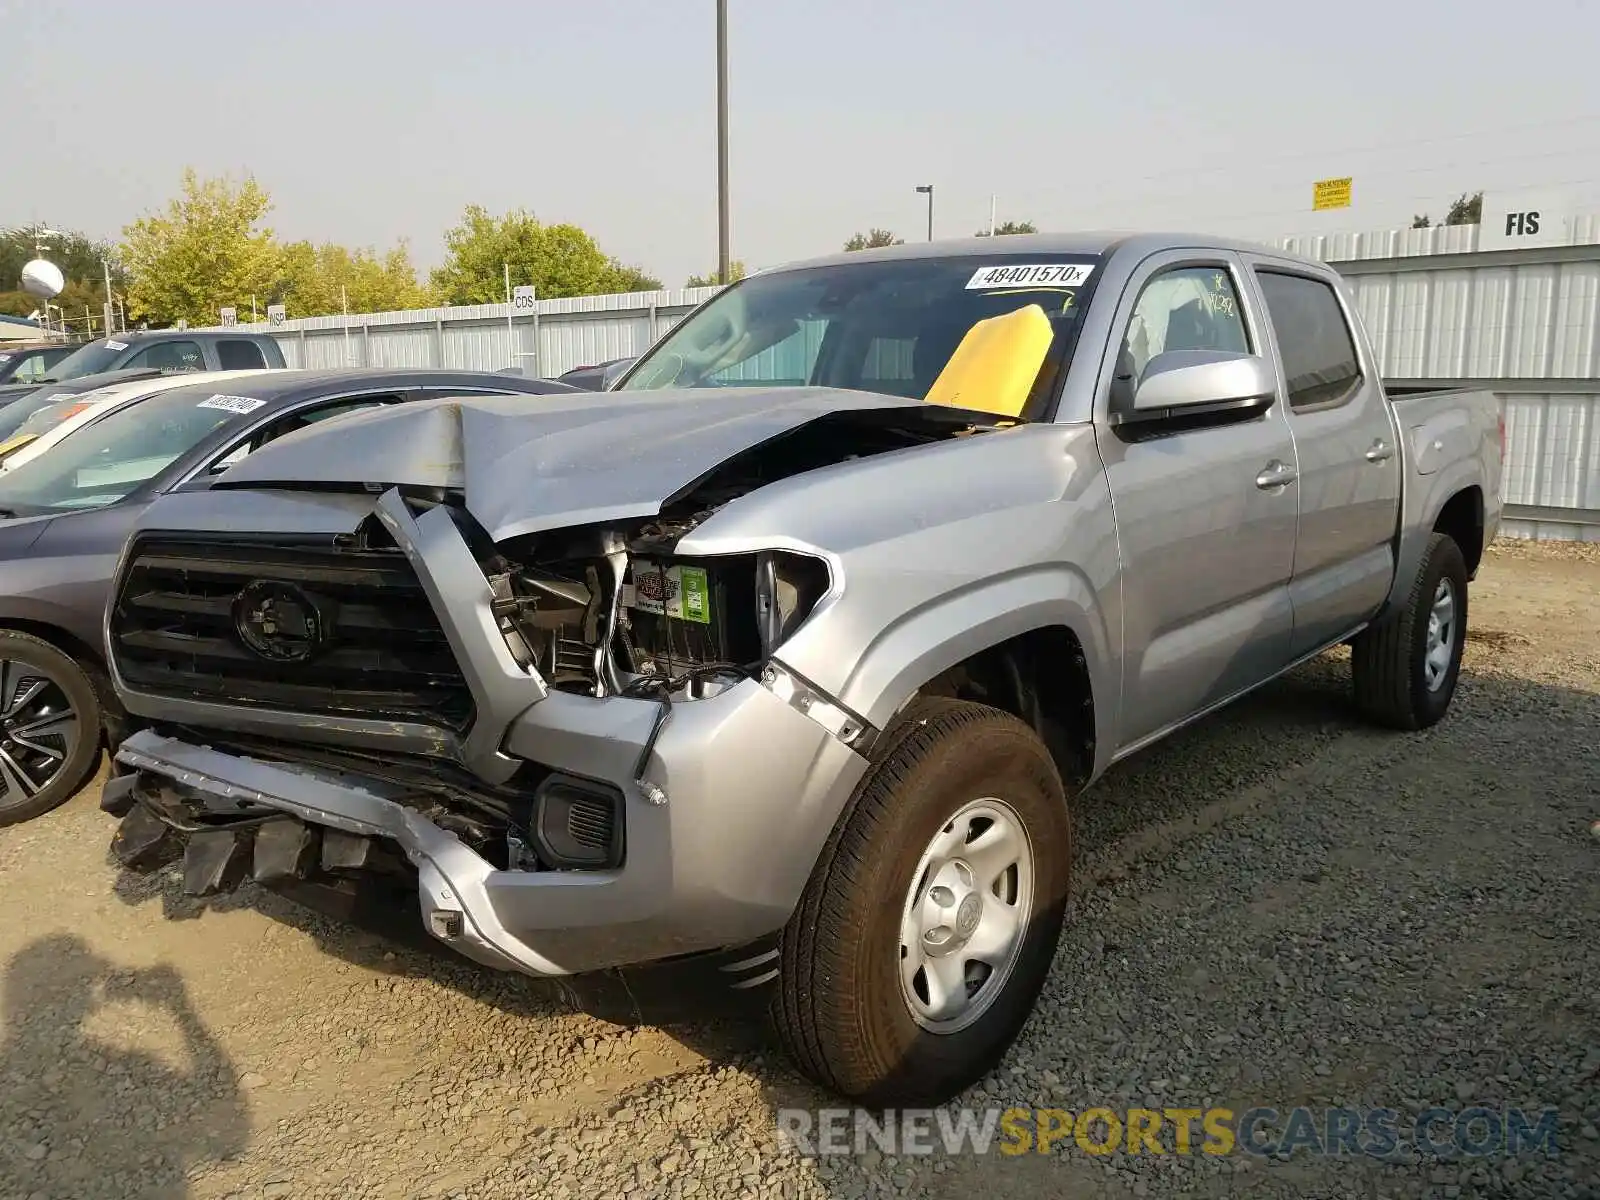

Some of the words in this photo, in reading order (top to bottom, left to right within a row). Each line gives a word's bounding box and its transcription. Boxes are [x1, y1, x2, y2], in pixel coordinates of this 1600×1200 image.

[1505, 211, 1540, 236] FIS
[515, 296, 534, 308] CDS
[269, 313, 285, 327] INSP
